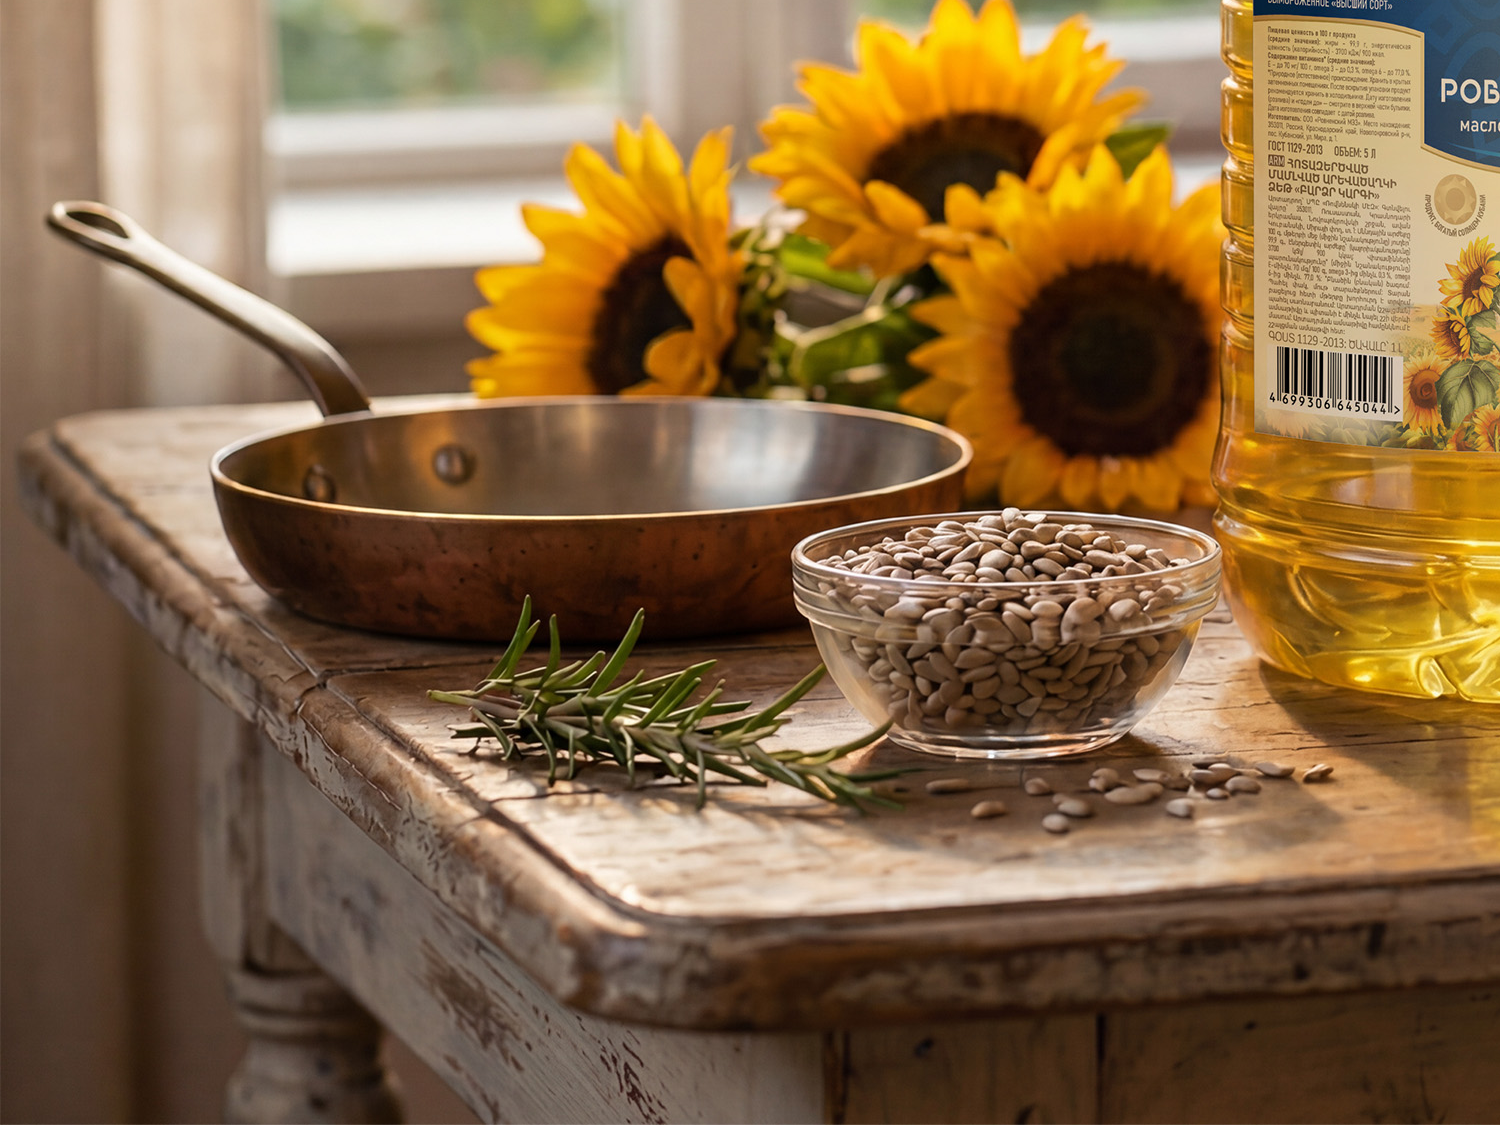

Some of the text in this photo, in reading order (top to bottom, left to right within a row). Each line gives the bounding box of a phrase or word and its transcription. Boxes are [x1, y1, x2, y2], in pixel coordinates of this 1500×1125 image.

[1370, 0, 1392, 10] СОРТ»
[1268, 140, 1376, 159] ГОСТ 1129-2013 ОБЪЕМ: 5 Л
[1269, 156, 1284, 166] ARM
[1298, 334, 1318, 345] 1129
[1270, 392, 1386, 414] 4 699306 645044
